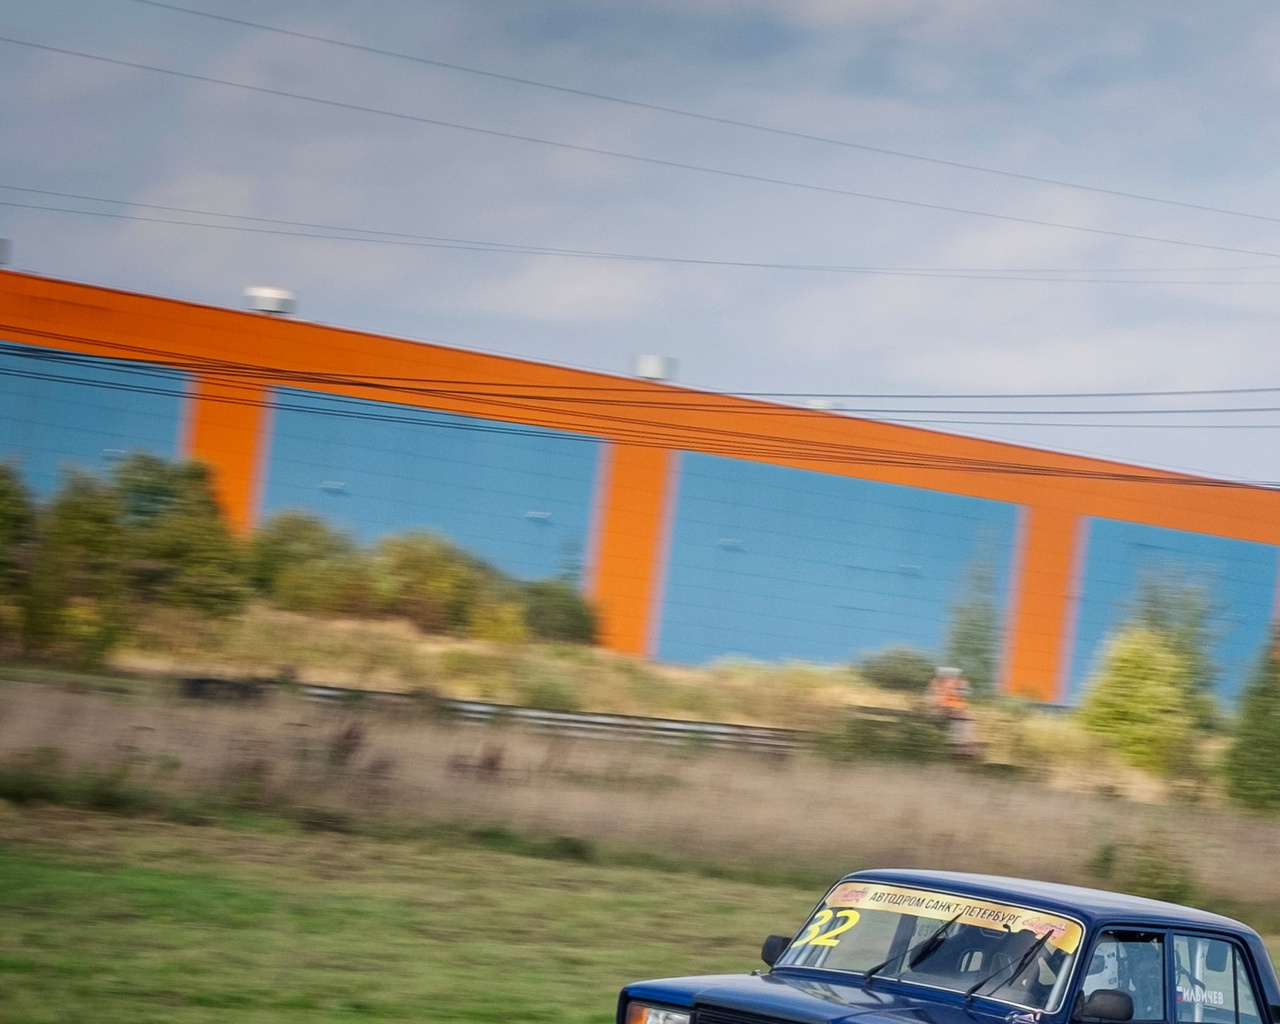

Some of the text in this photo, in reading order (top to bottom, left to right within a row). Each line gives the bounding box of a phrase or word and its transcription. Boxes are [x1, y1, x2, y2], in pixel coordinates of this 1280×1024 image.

[869, 891, 926, 907] АВТОДРОМ
[925, 899, 1022, 925] САНКТ-ПЕТЕРБУРГ
[790, 909, 860, 949] 32
